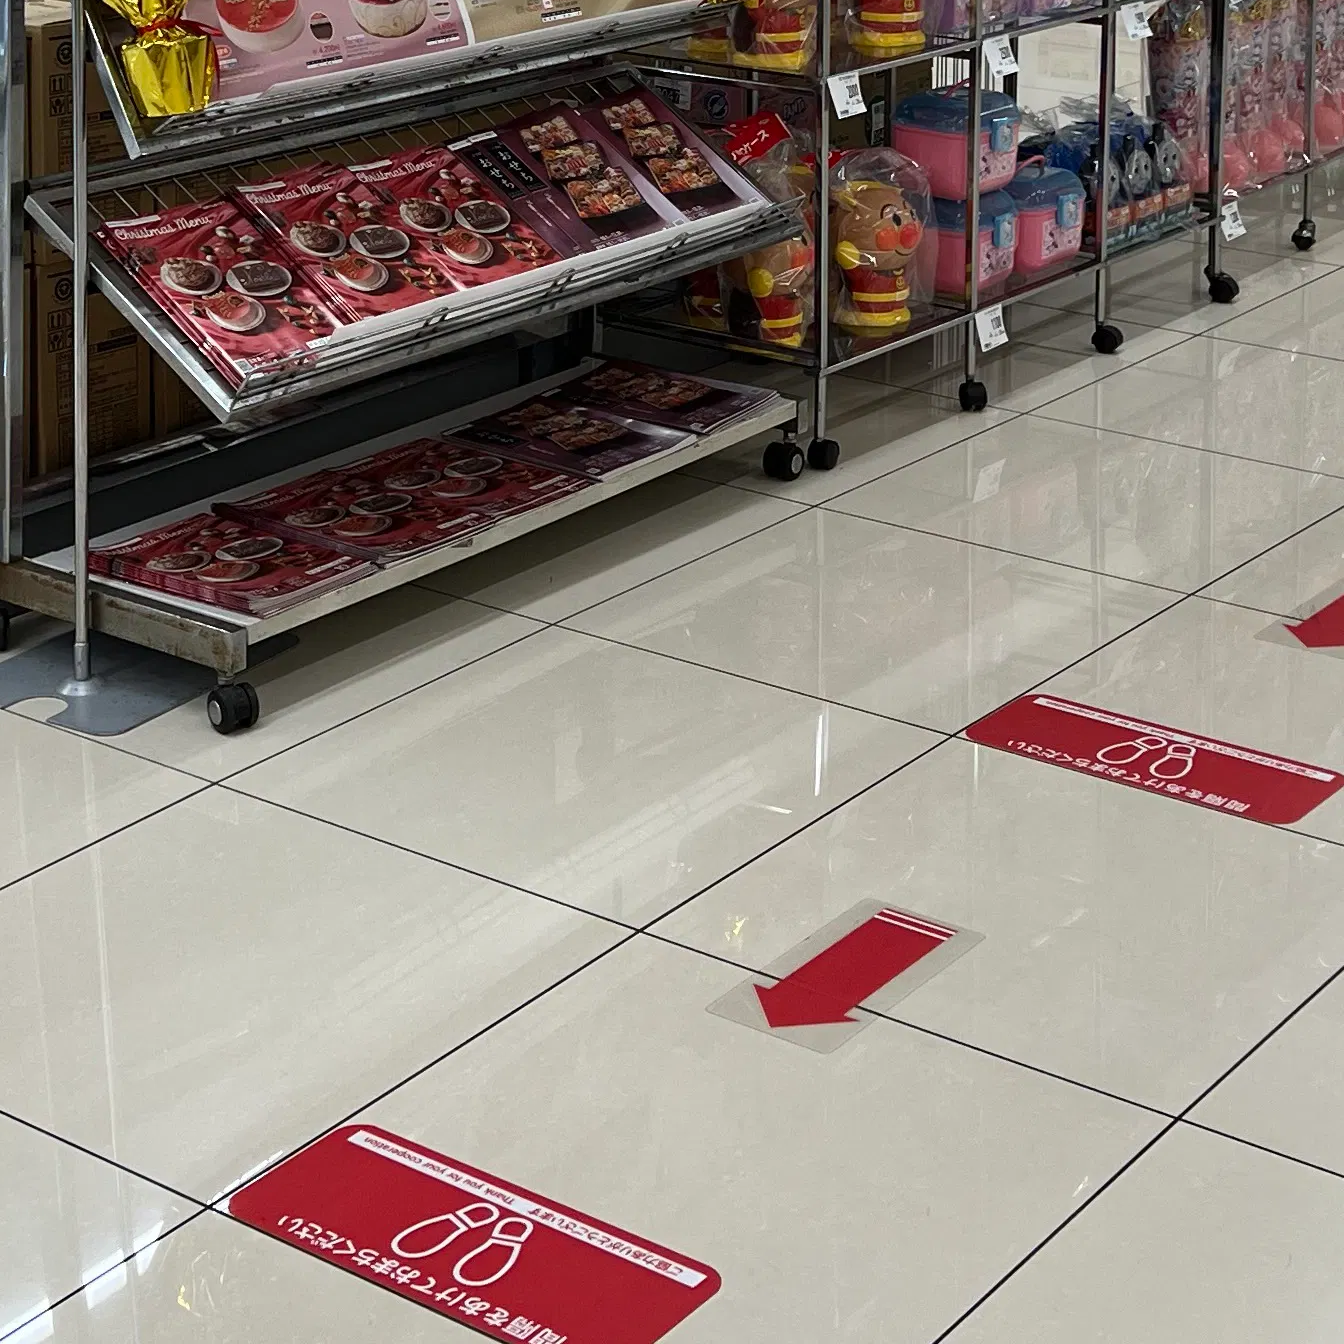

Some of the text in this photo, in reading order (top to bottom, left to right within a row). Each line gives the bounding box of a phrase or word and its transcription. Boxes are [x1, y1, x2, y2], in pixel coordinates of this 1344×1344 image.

[357, 158, 436, 183] Christmas Menu
[247, 180, 333, 205] Christmas Menu
[114, 215, 213, 241] Christmas Menu
[363, 1135, 516, 1207] Thank you for your cooperation
